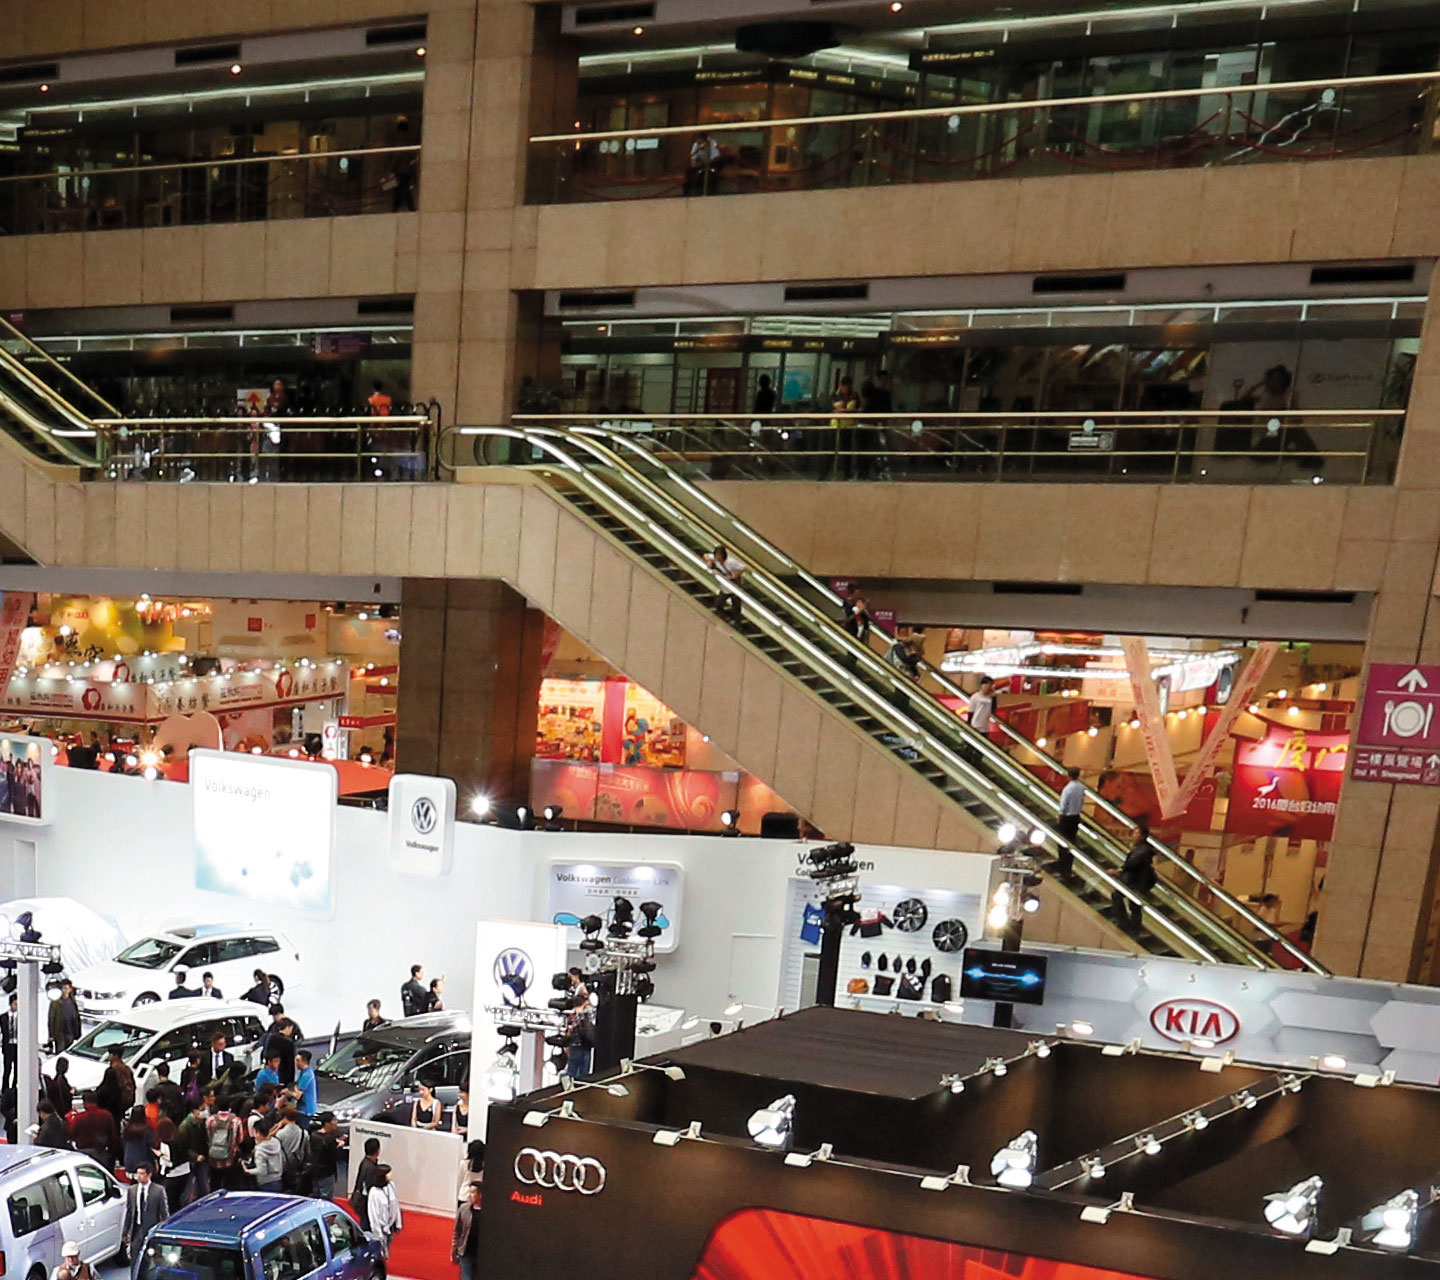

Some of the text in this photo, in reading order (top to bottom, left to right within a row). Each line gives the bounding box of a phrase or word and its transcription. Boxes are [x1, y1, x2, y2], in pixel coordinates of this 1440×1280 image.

[204, 777, 272, 802] Volkswagen
[405, 840, 439, 852] Volkswagen
[556, 872, 612, 885] Volkswagen
[1165, 1006, 1222, 1038] KIA
[355, 1126, 393, 1138] Information
[511, 1191, 542, 1206] Audi
